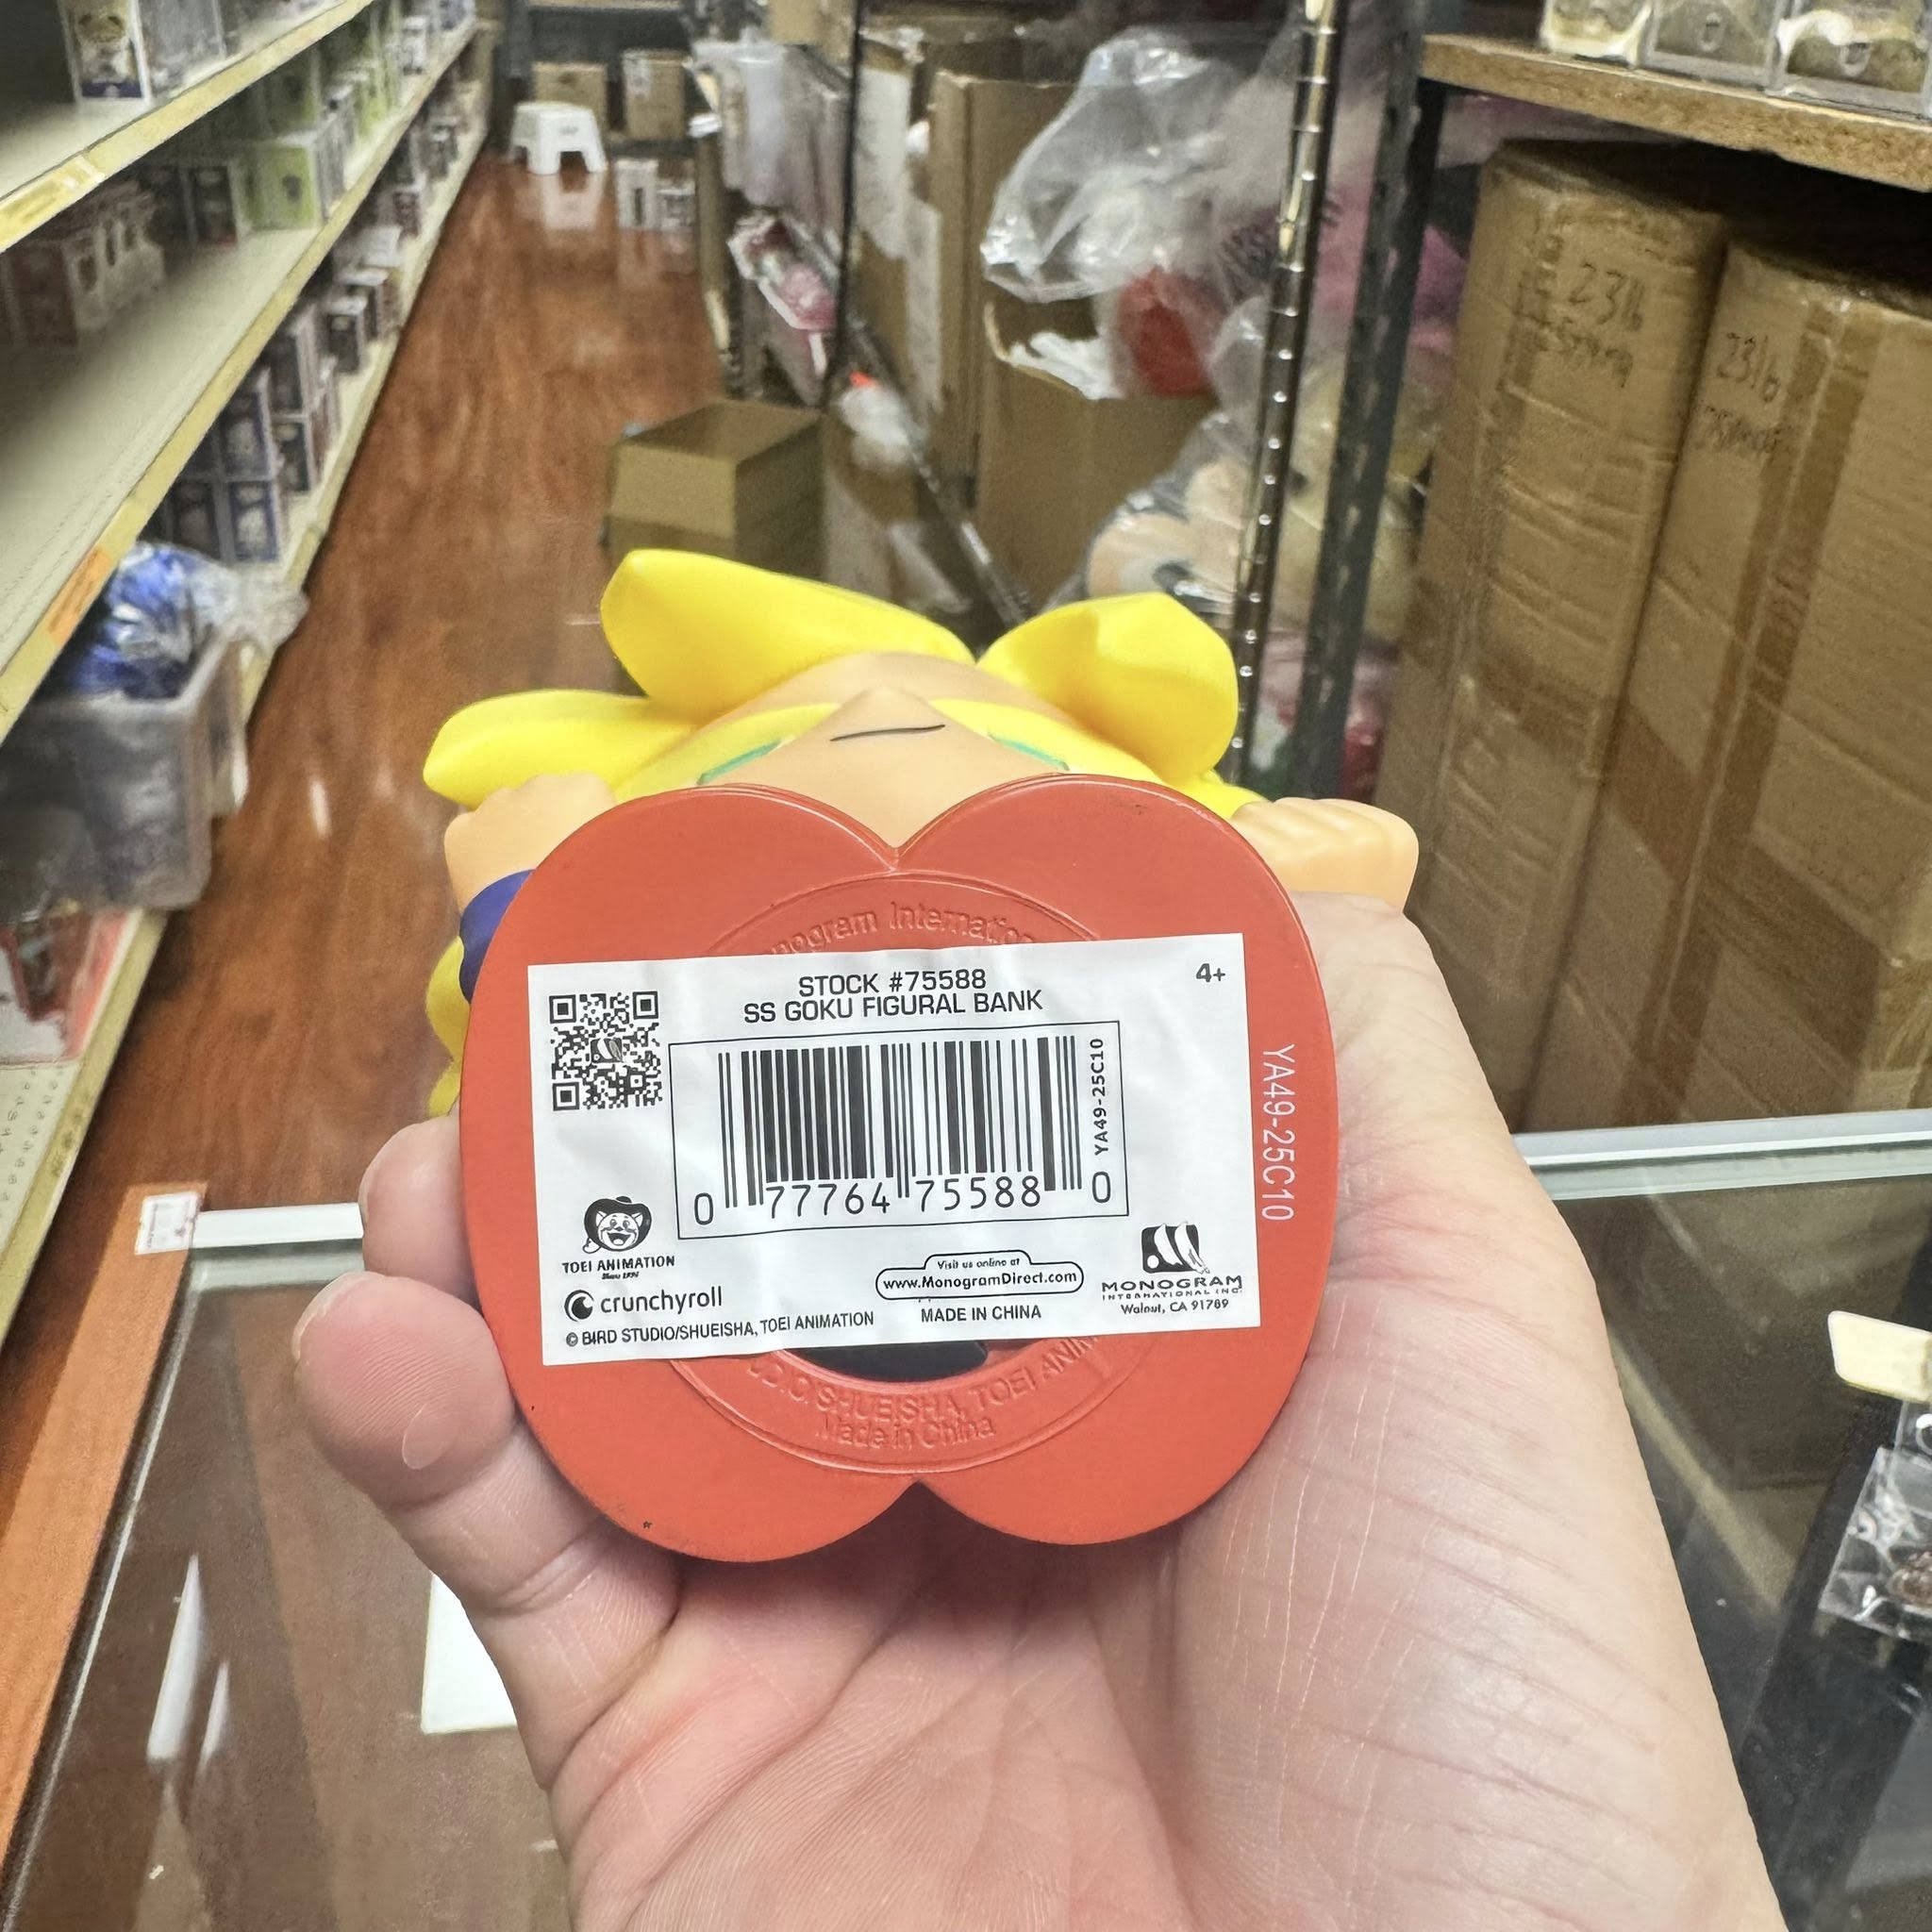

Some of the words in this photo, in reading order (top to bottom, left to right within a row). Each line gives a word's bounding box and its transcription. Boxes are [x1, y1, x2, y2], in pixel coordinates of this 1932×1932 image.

[798, 973, 878, 997] STOCK
[889, 969, 987, 991] #75588
[1195, 962, 1226, 983] 4+
[743, 1003, 776, 1024] SS
[785, 997, 854, 1022] GOKU
[863, 992, 966, 1018] FIGURAL
[974, 990, 1043, 1014] BANK
[1091, 1038, 1108, 1156] YA49-25C10
[1262, 1043, 1296, 1222] YA49-25C10
[693, 1192, 714, 1225] 0
[765, 1182, 891, 1220] 77764
[914, 1175, 1041, 1212] 75588
[1091, 1171, 1111, 1204] 0
[561, 1259, 592, 1274] TOEI
[597, 1255, 675, 1272] ANIMATION
[937, 1259, 959, 1271] Visit
[962, 1261, 974, 1270] us
[883, 1271, 1077, 1291] www.MonogramDirect.com
[1102, 1274, 1242, 1292] MONOGRAM
[601, 1286, 723, 1315] crunchyroll
[1170, 1301, 1189, 1318] CA
[921, 1307, 967, 1324] MADE
[972, 1307, 987, 1322] IN
[991, 1304, 1041, 1321] CHINA
[582, 1325, 617, 1346] BIRD
[622, 1321, 758, 1343] STUDIO/SHUEISHA,
[760, 1316, 791, 1335] TOEI
[795, 1310, 874, 1330] ANIMATION
